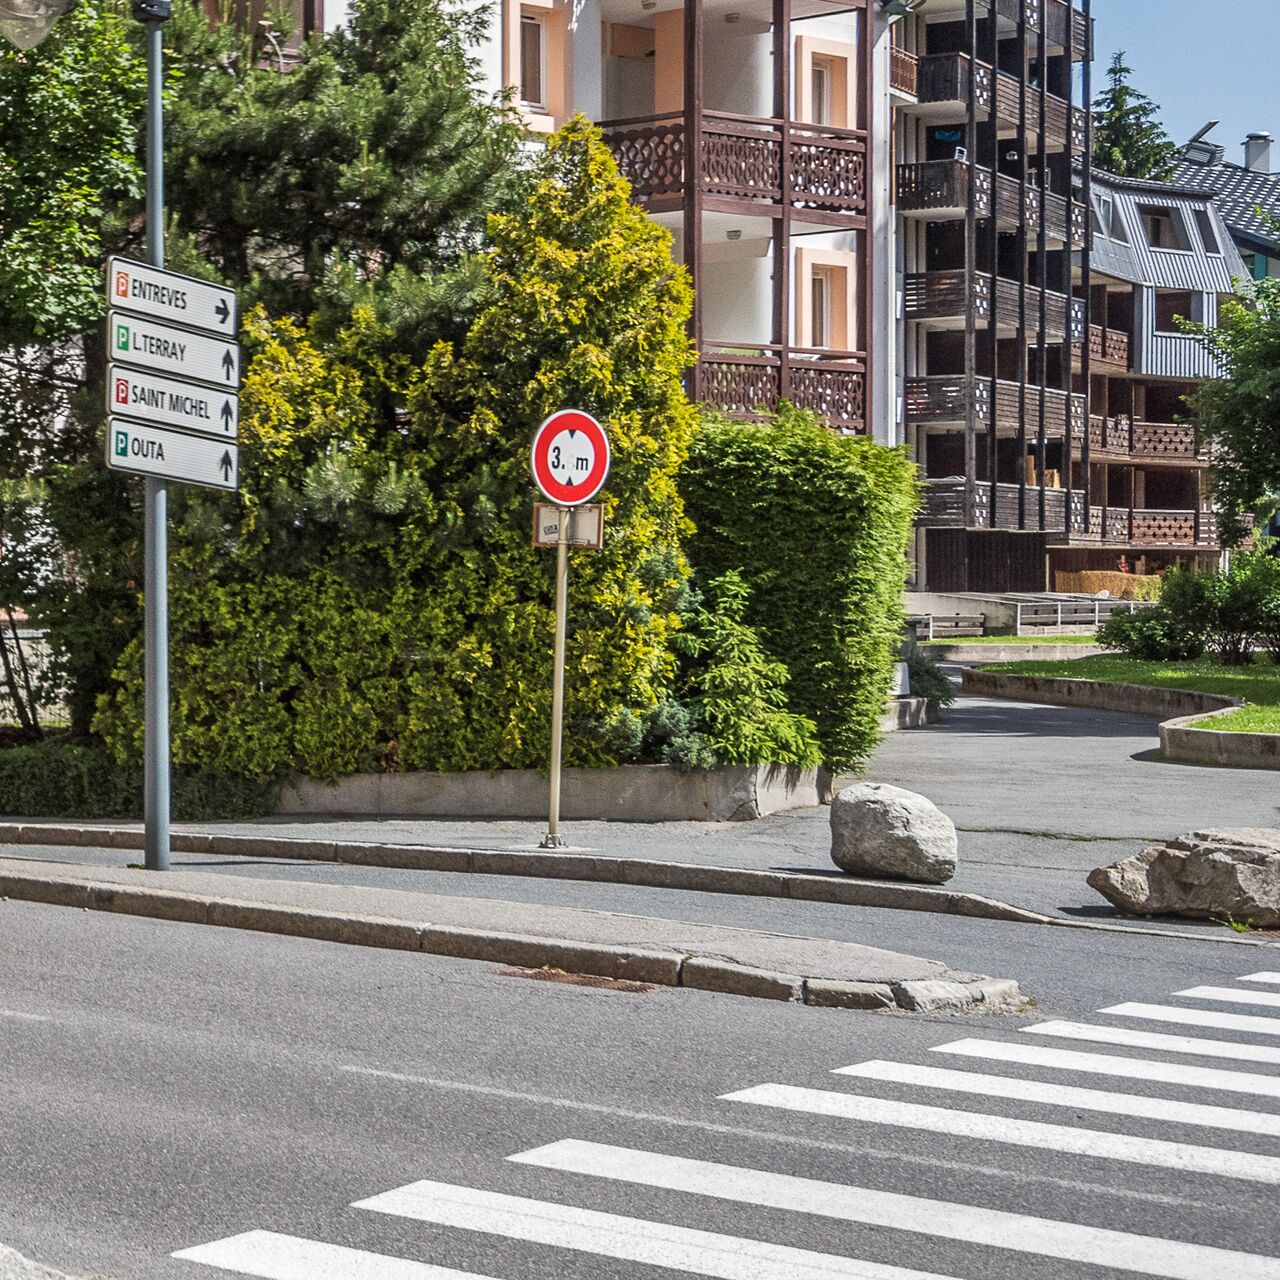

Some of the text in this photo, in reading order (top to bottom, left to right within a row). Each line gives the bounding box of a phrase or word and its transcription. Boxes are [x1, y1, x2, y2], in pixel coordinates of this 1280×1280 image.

[131, 278, 187, 310] ENTREVES
[132, 332, 186, 361] L.TERRAY
[131, 384, 166, 410] SAINT
[169, 393, 210, 419] MICHEL
[131, 436, 165, 461] OUTA
[575, 456, 589, 471] m
